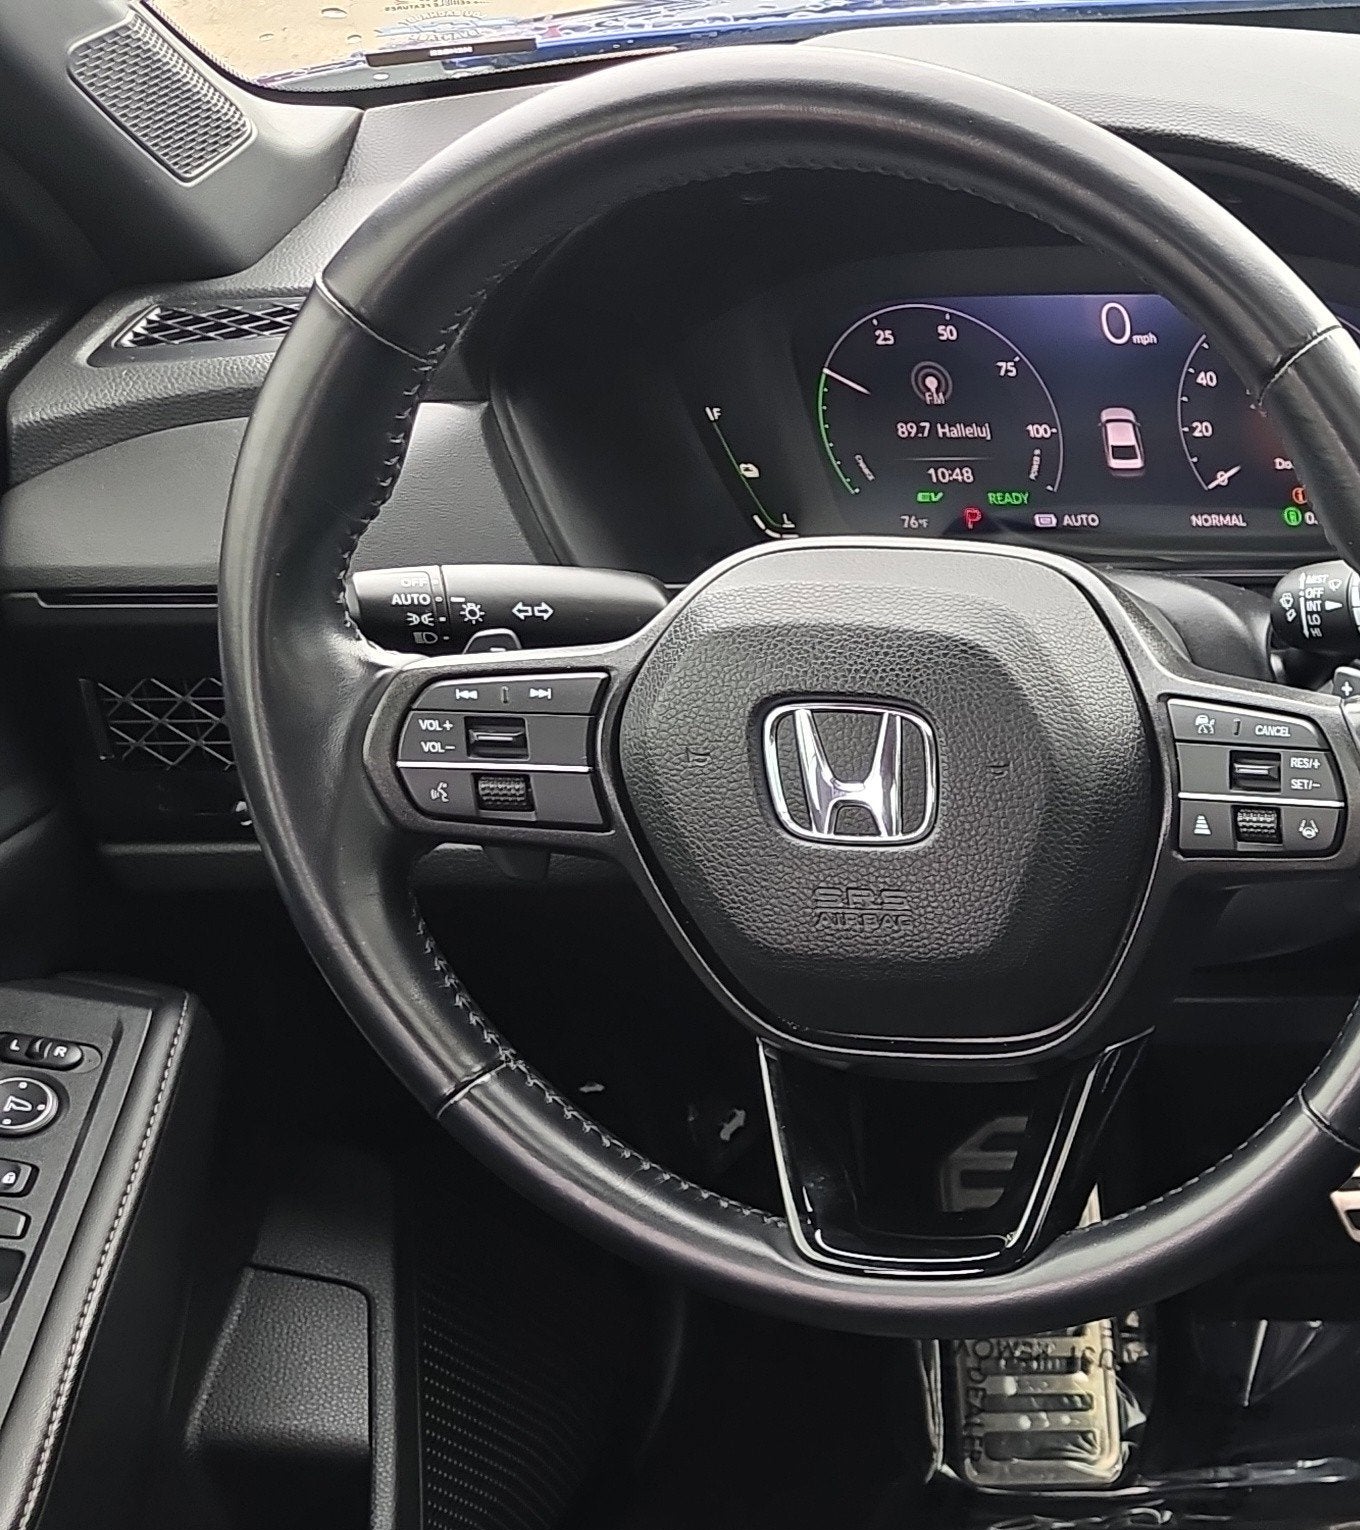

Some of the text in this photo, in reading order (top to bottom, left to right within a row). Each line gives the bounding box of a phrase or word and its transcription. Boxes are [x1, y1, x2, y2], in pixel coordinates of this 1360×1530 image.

[1101, 302, 1158, 346] 0 mph
[874, 330, 895, 346] 25
[937, 324, 958, 341] 50
[996, 361, 1017, 377] 75
[1196, 372, 1217, 387] 40
[896, 422, 993, 441] 89.7 Halleluj
[1026, 424, 1052, 439] 100
[1191, 422, 1213, 437] 20
[927, 467, 975, 486] 10:48
[987, 491, 1029, 506] READY
[1063, 514, 1099, 527] AUTO
[1190, 514, 1247, 527] NORMAL
[400, 576, 429, 588] OFF
[1305, 587, 1325, 599] OFF
[391, 594, 431, 606] AUTO
[1306, 600, 1321, 612] INT
[1307, 613, 1321, 626] LO
[1255, 724, 1291, 737] CANCEL
[1290, 757, 1321, 770] RES/+
[9, 1038, 20, 1051] L
[53, 1045, 67, 1057] R
